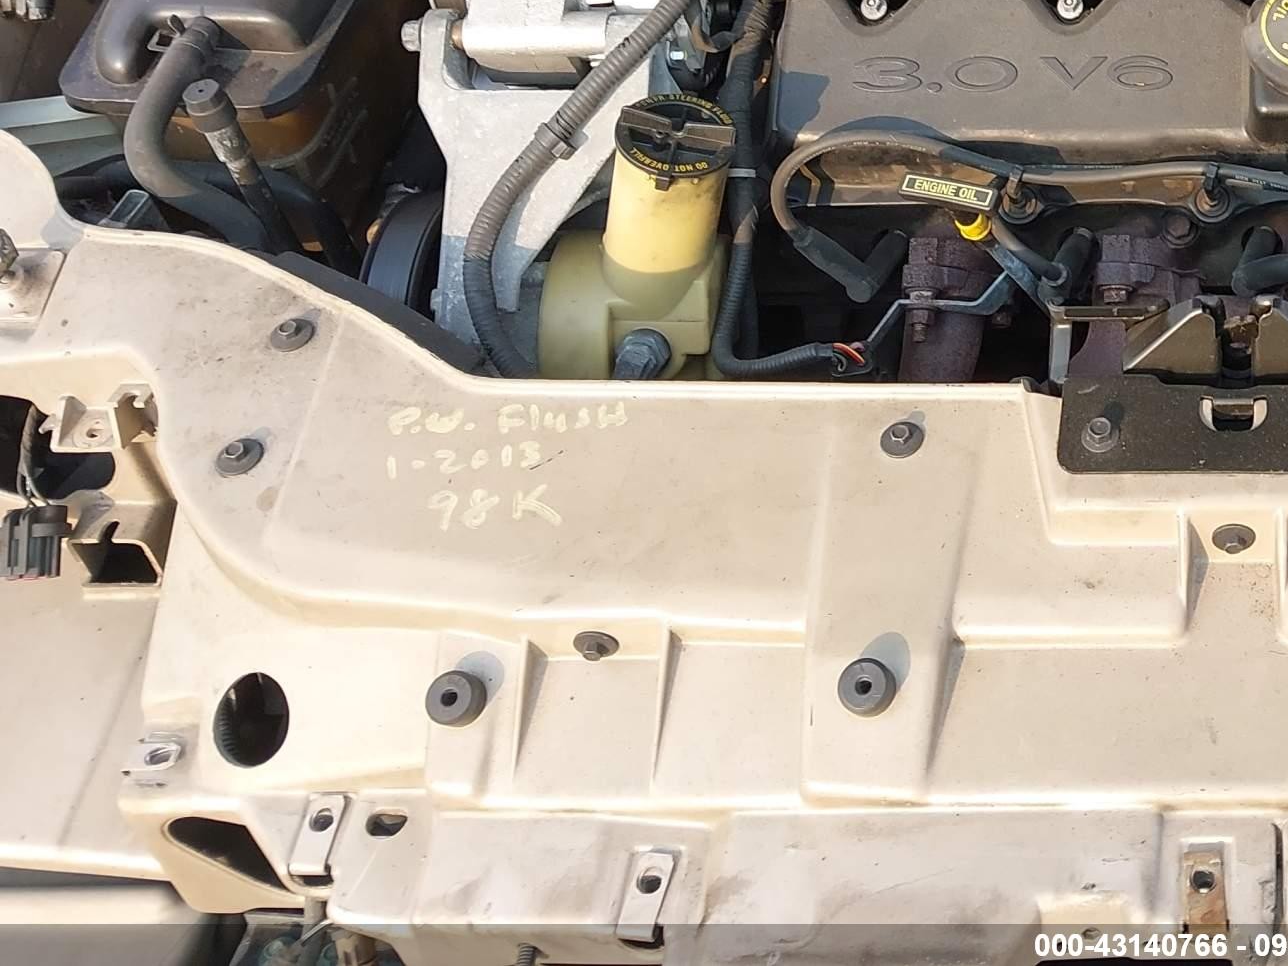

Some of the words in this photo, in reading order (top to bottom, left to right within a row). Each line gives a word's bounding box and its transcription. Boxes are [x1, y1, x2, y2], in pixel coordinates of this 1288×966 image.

[852, 56, 1019, 92] 3.0
[1040, 55, 1174, 91] V6
[629, 147, 669, 170] OVERFILL
[674, 164, 693, 172] NOT
[695, 161, 708, 170] DO
[914, 179, 957, 196] ENGINE
[958, 187, 978, 201] OIL
